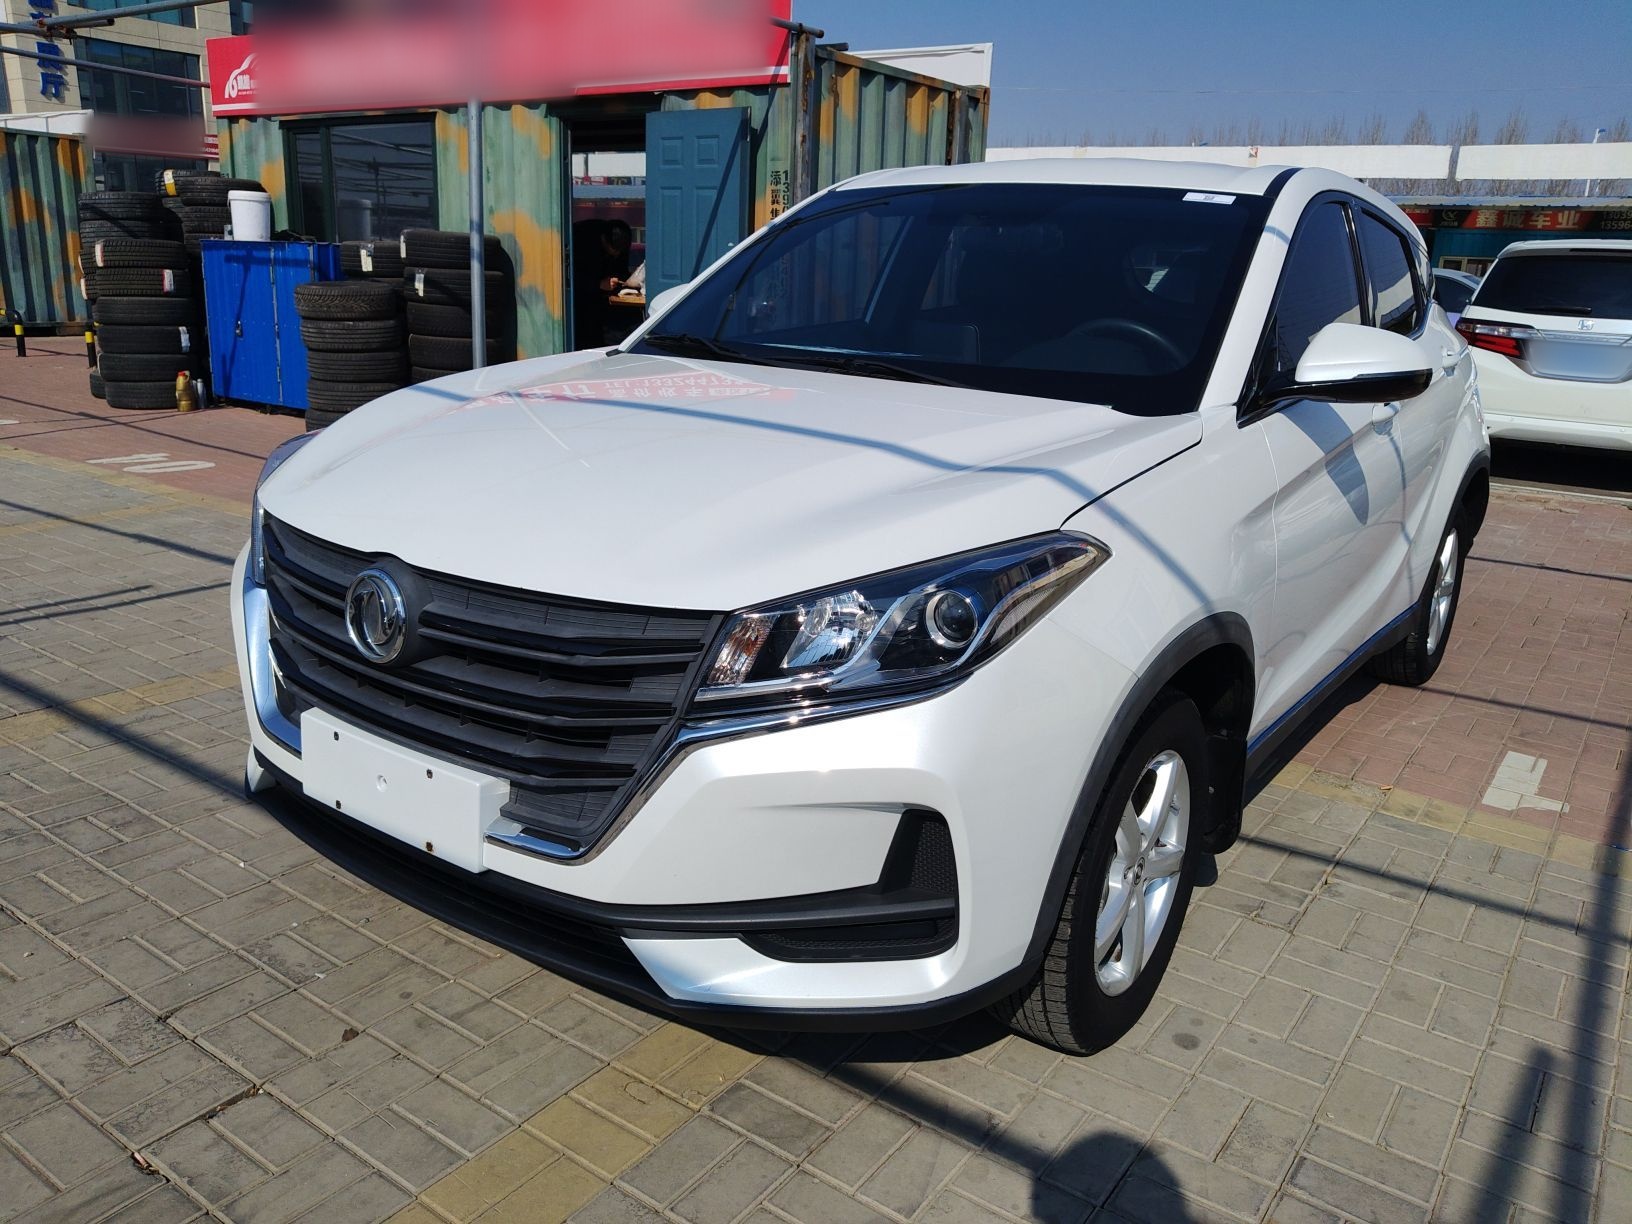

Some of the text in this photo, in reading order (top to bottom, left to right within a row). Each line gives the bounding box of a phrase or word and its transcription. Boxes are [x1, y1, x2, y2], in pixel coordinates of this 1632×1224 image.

[1475, 209, 1580, 229] 鑫诚车业
[1600, 220, 1632, 230] 13596
